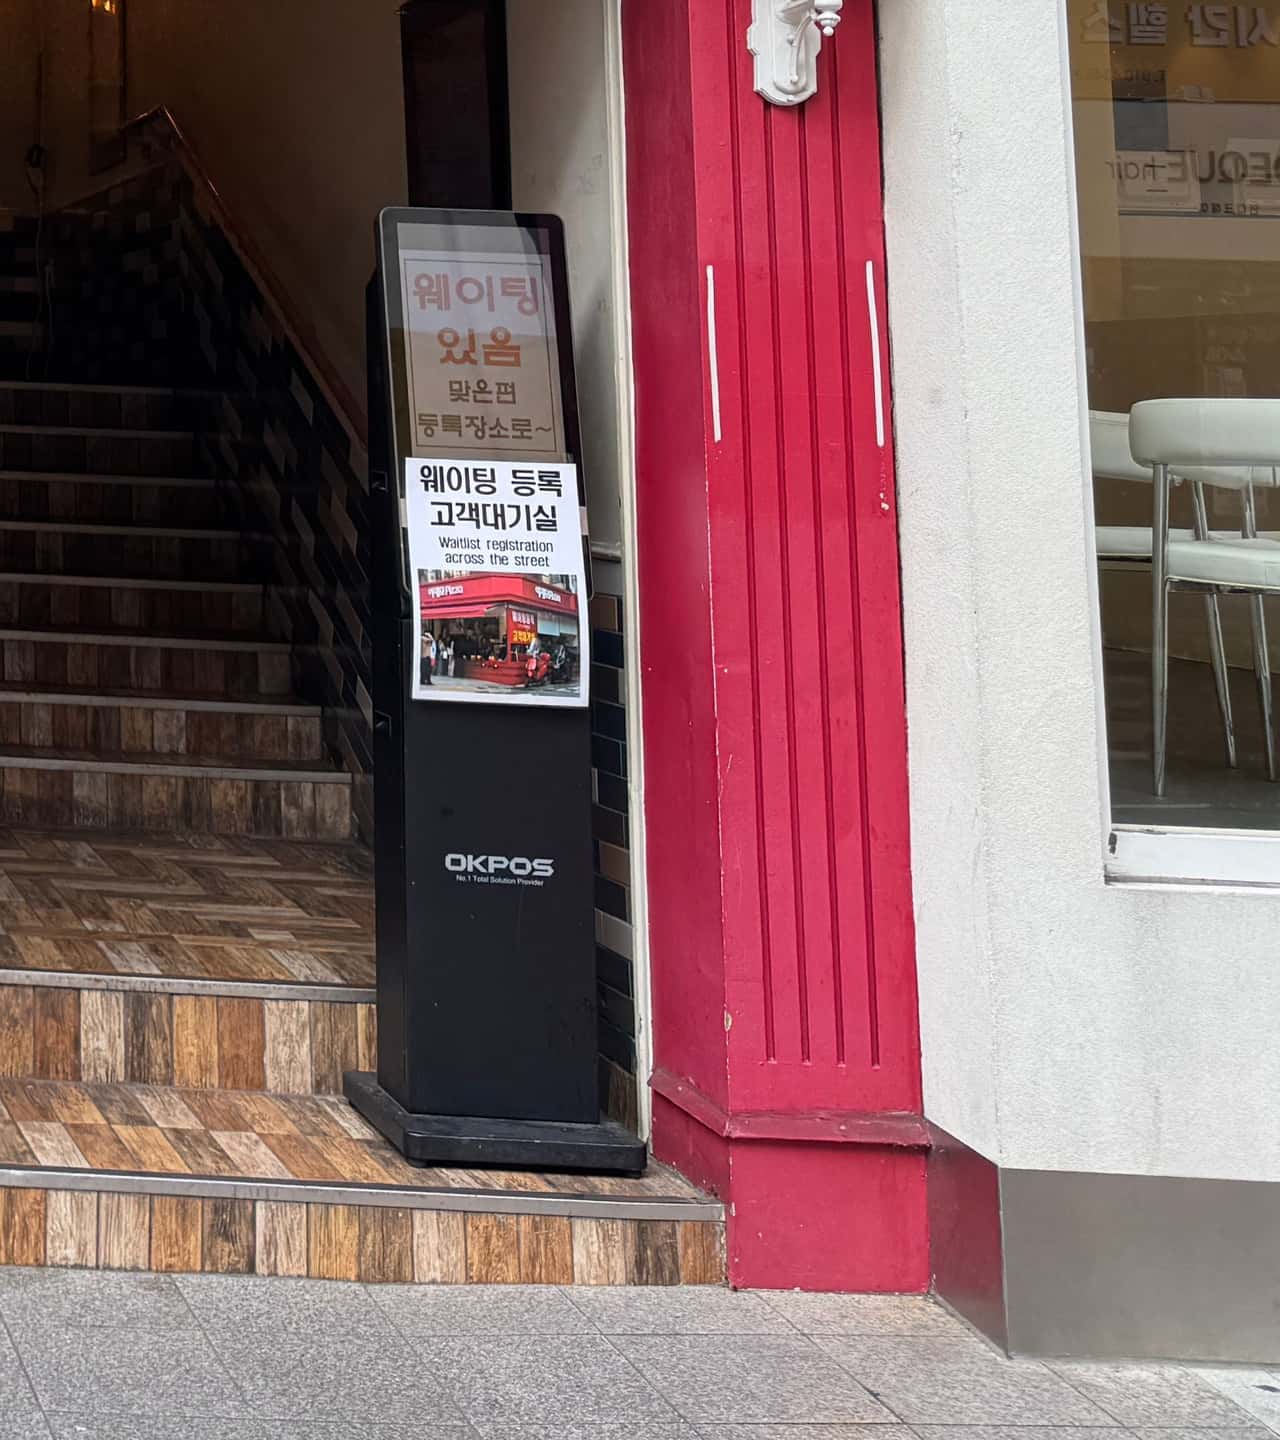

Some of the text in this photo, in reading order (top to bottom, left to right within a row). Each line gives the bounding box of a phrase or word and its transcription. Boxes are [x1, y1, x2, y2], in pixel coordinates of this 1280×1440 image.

[413, 273, 539, 317] 웨이팅
[438, 326, 522, 368] 있음
[448, 378, 517, 405] 맞은편
[419, 464, 563, 498] 웨이팅 등록
[429, 500, 558, 533] 고객대기실
[438, 535, 554, 554] Waitlist registration
[444, 552, 550, 568] across the street
[444, 853, 555, 877] OKPOS
